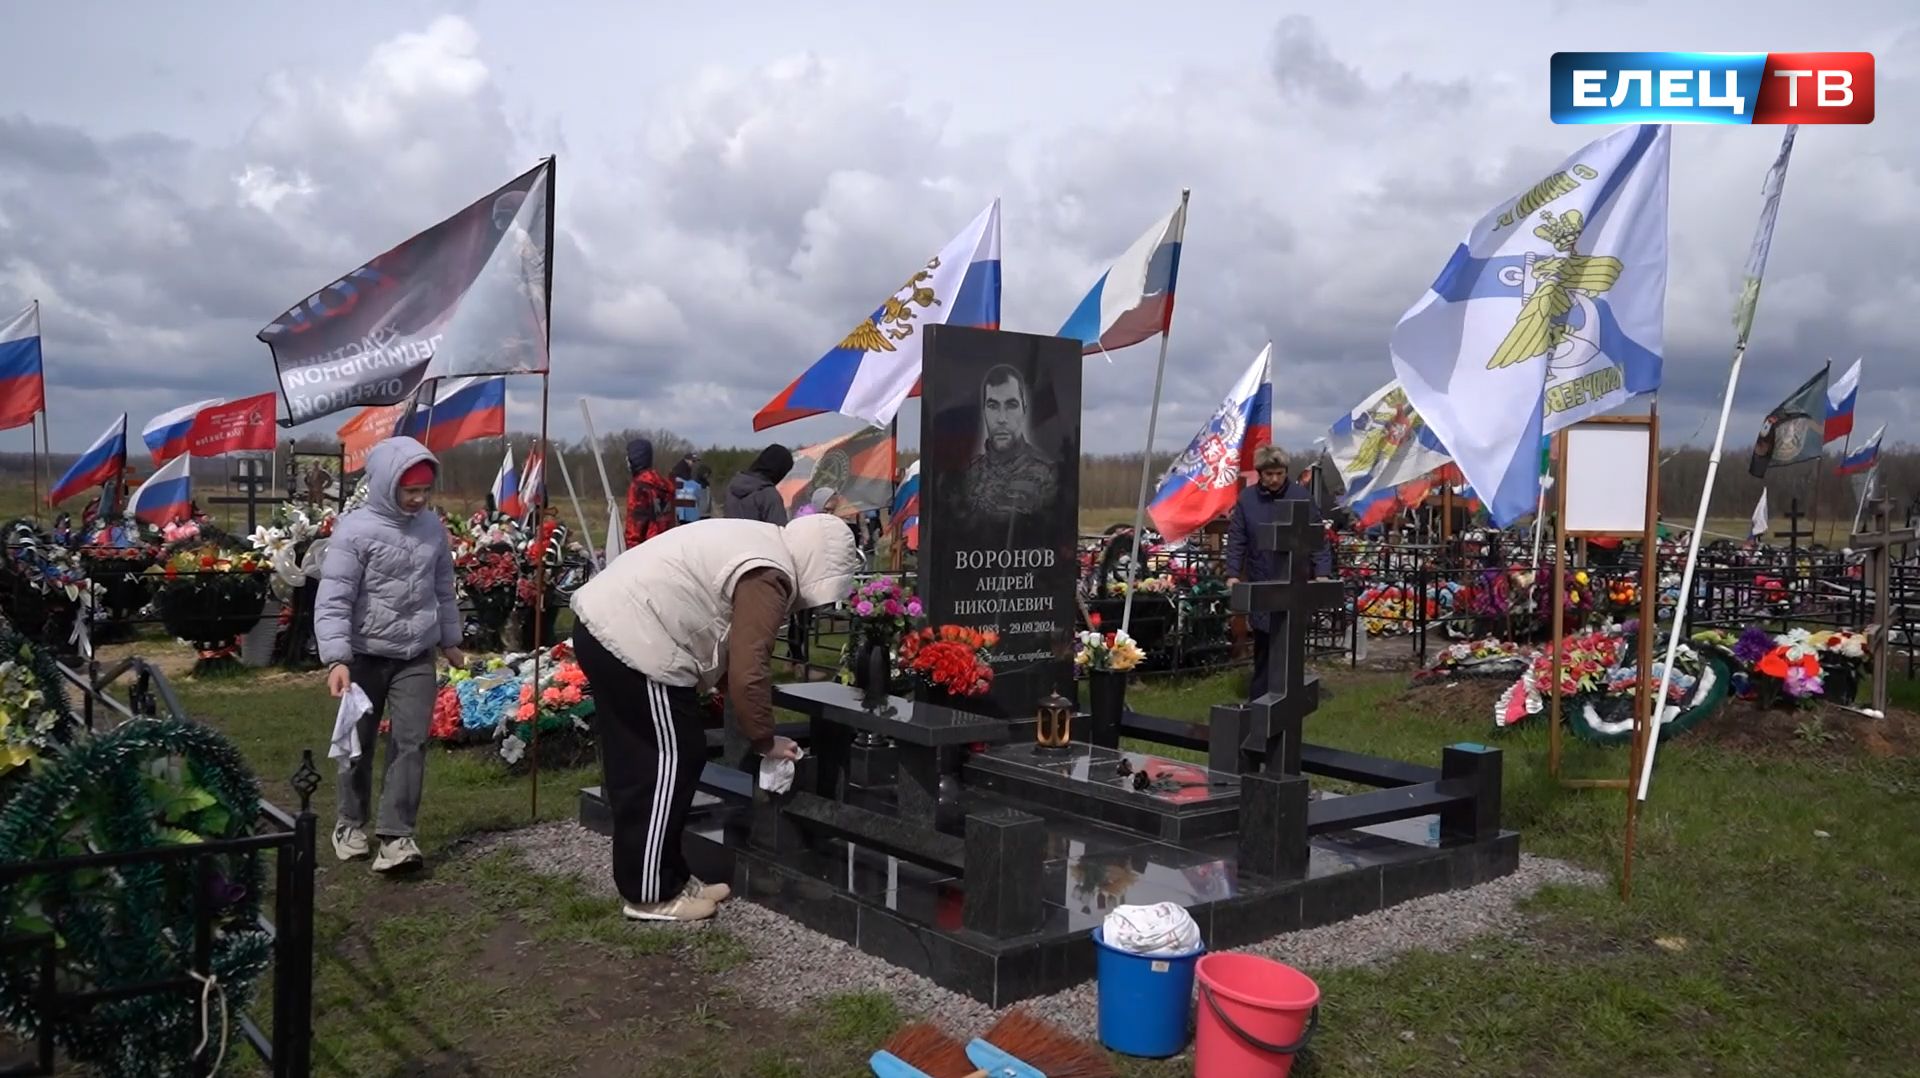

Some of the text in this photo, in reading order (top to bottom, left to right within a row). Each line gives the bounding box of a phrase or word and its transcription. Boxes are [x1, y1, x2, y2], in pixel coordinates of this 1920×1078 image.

[955, 549, 1055, 569] ВОРОНОВ
[975, 573, 1035, 592] АНДРЕЙ
[954, 596, 1054, 615] НИКОЛАЕВИЧ
